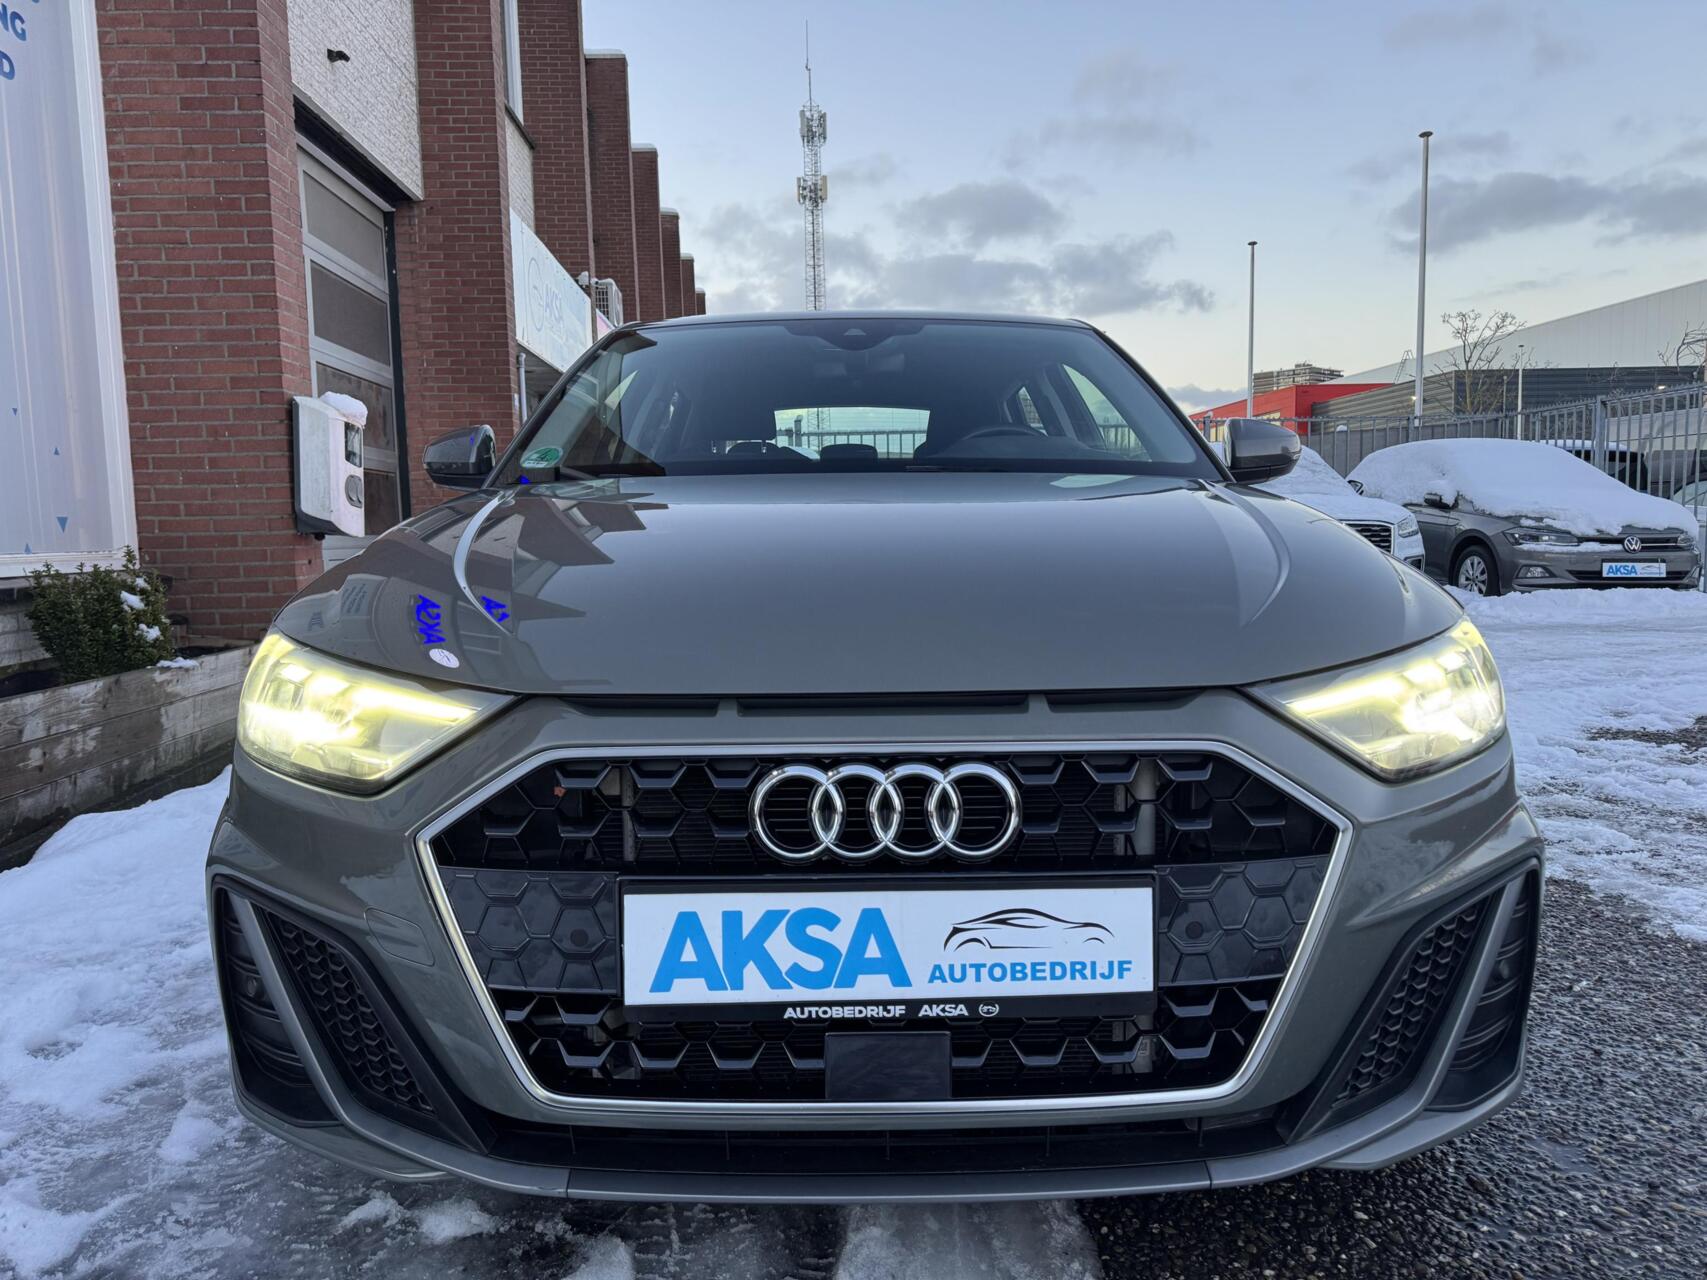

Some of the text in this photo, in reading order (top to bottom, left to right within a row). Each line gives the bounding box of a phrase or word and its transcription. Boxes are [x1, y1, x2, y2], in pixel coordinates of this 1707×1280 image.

[1606, 565, 1638, 576] AKSA
[649, 908, 913, 992] AKSA
[927, 960, 1132, 984] AUTOBEDRIJF
[783, 1003, 969, 1019] AUTOBEDRIJF AKSA
